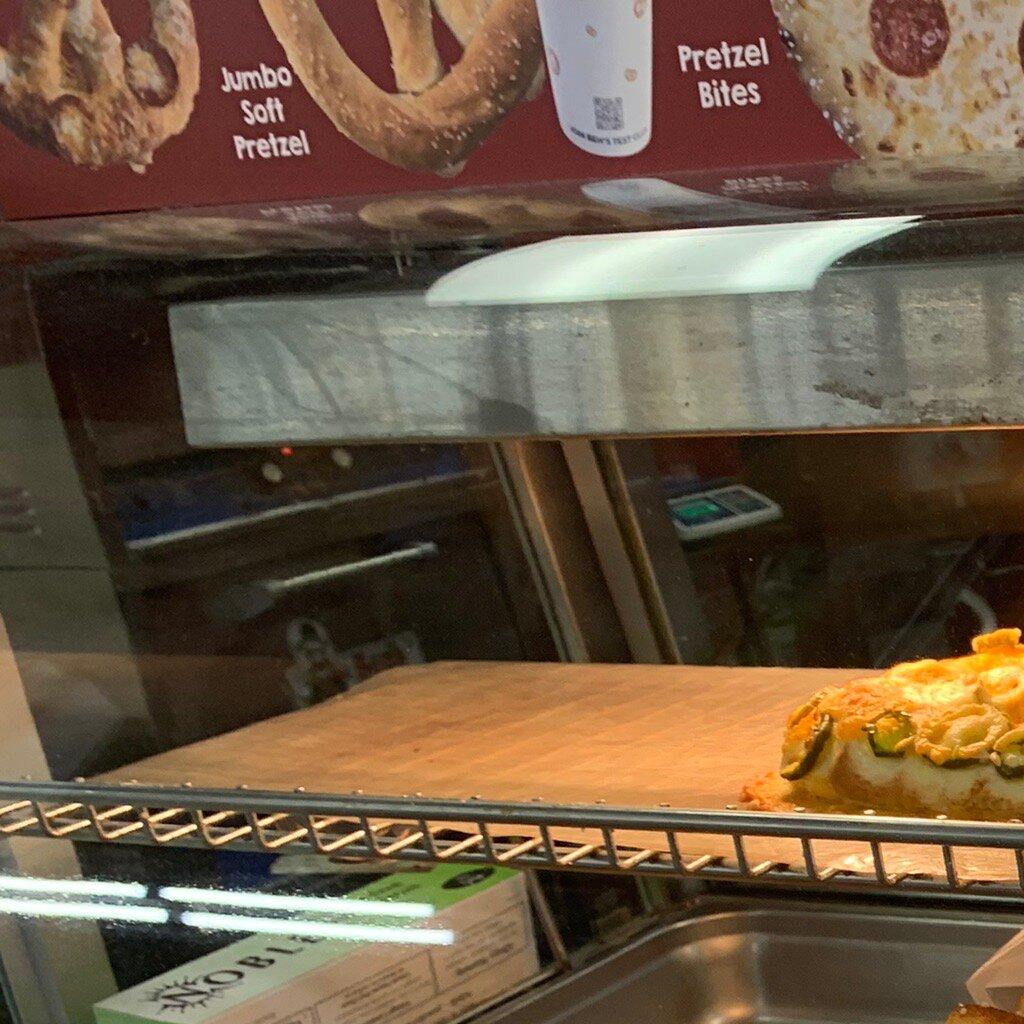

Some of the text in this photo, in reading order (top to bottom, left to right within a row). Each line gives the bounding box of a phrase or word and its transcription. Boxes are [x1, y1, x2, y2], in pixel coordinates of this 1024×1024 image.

[677, 37, 770, 73] Pretzel
[221, 62, 293, 93] Jumbo
[697, 79, 762, 109] Bites
[240, 96, 286, 126] Soft
[232, 129, 311, 160] Pretzel
